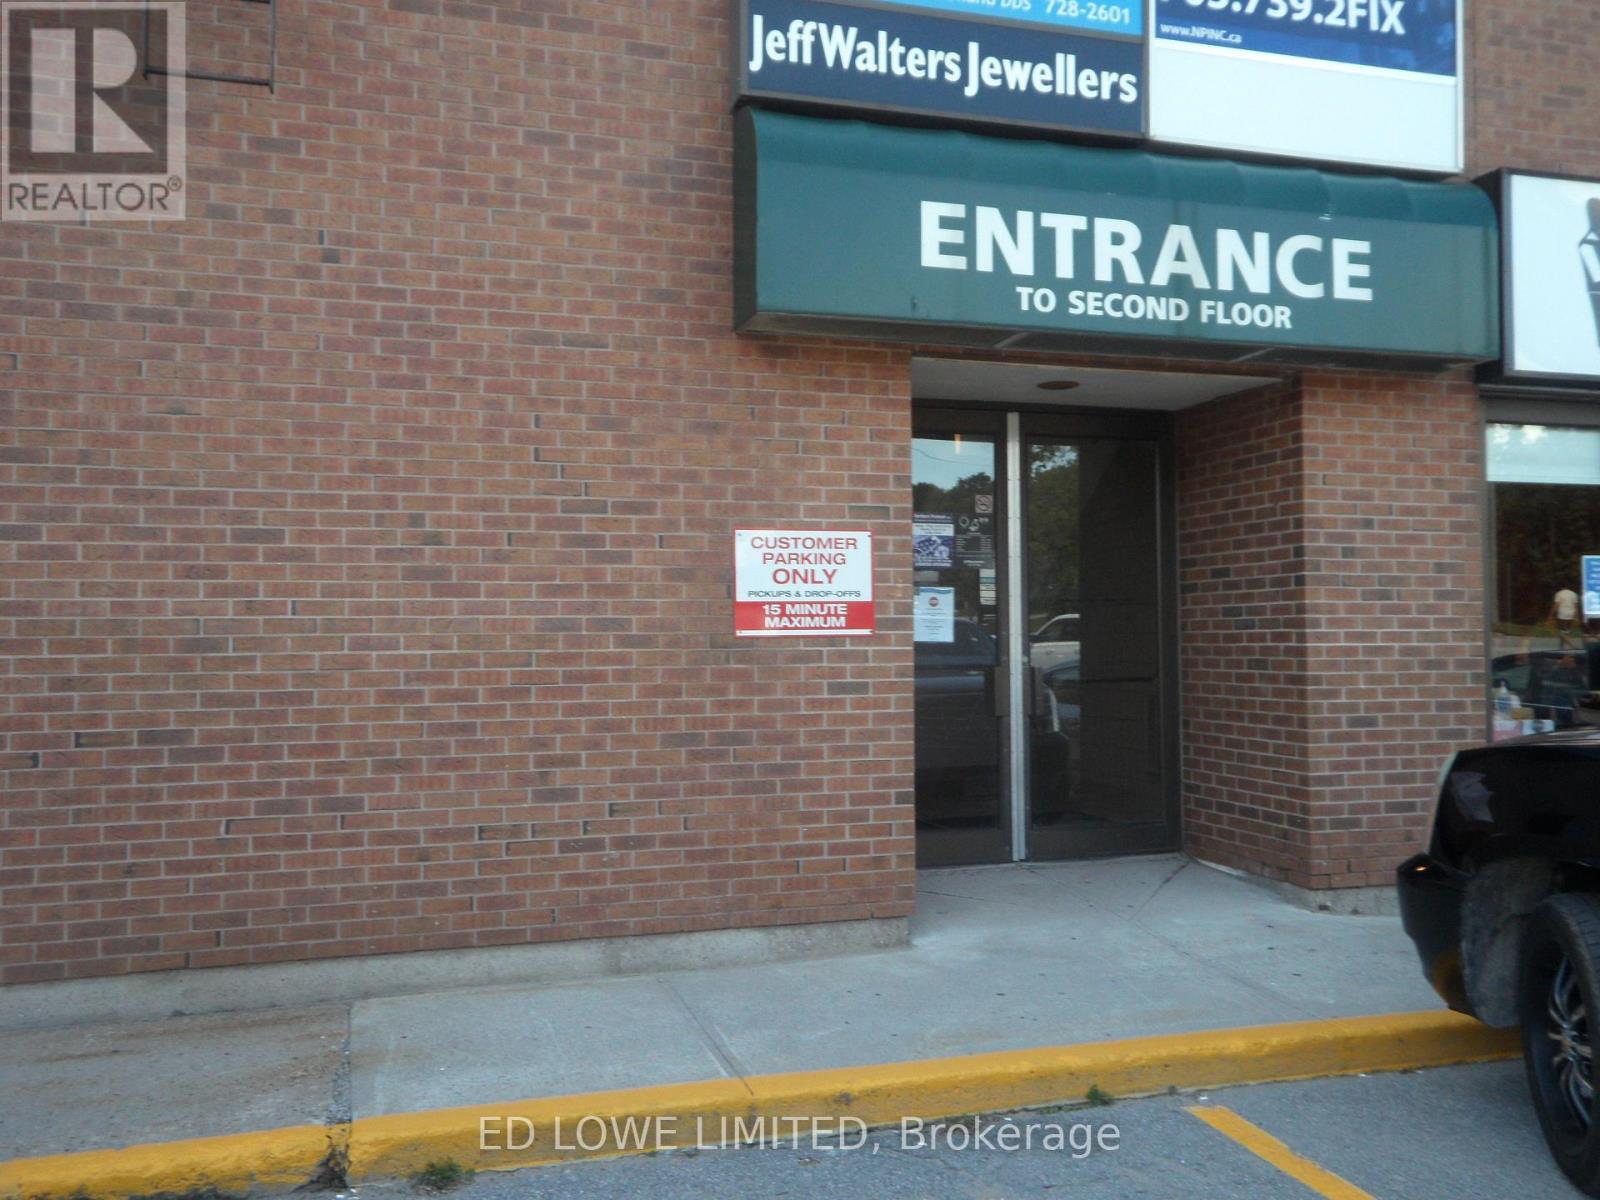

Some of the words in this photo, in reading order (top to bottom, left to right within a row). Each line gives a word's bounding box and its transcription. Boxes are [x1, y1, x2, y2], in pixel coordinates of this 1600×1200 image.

[1045, 0, 1131, 25] 728-2601
[1160, 0, 1406, 35] .39.2FIX
[919, 200, 1373, 301] ENTRANCE
[1016, 286, 1056, 313] TO
[1068, 290, 1190, 322] SECOND
[1201, 300, 1292, 329] FLOOR
[751, 536, 857, 550] CUSTOMER
[763, 553, 846, 565] PARKING
[772, 568, 838, 584] ONLY
[748, 590, 792, 598] PICKUPS
[795, 590, 801, 598] &
[804, 590, 861, 598] DROP-OFFS
[762, 603, 781, 615] 15
[785, 603, 848, 615] MINUTE
[764, 616, 846, 628] MAXIMUM
